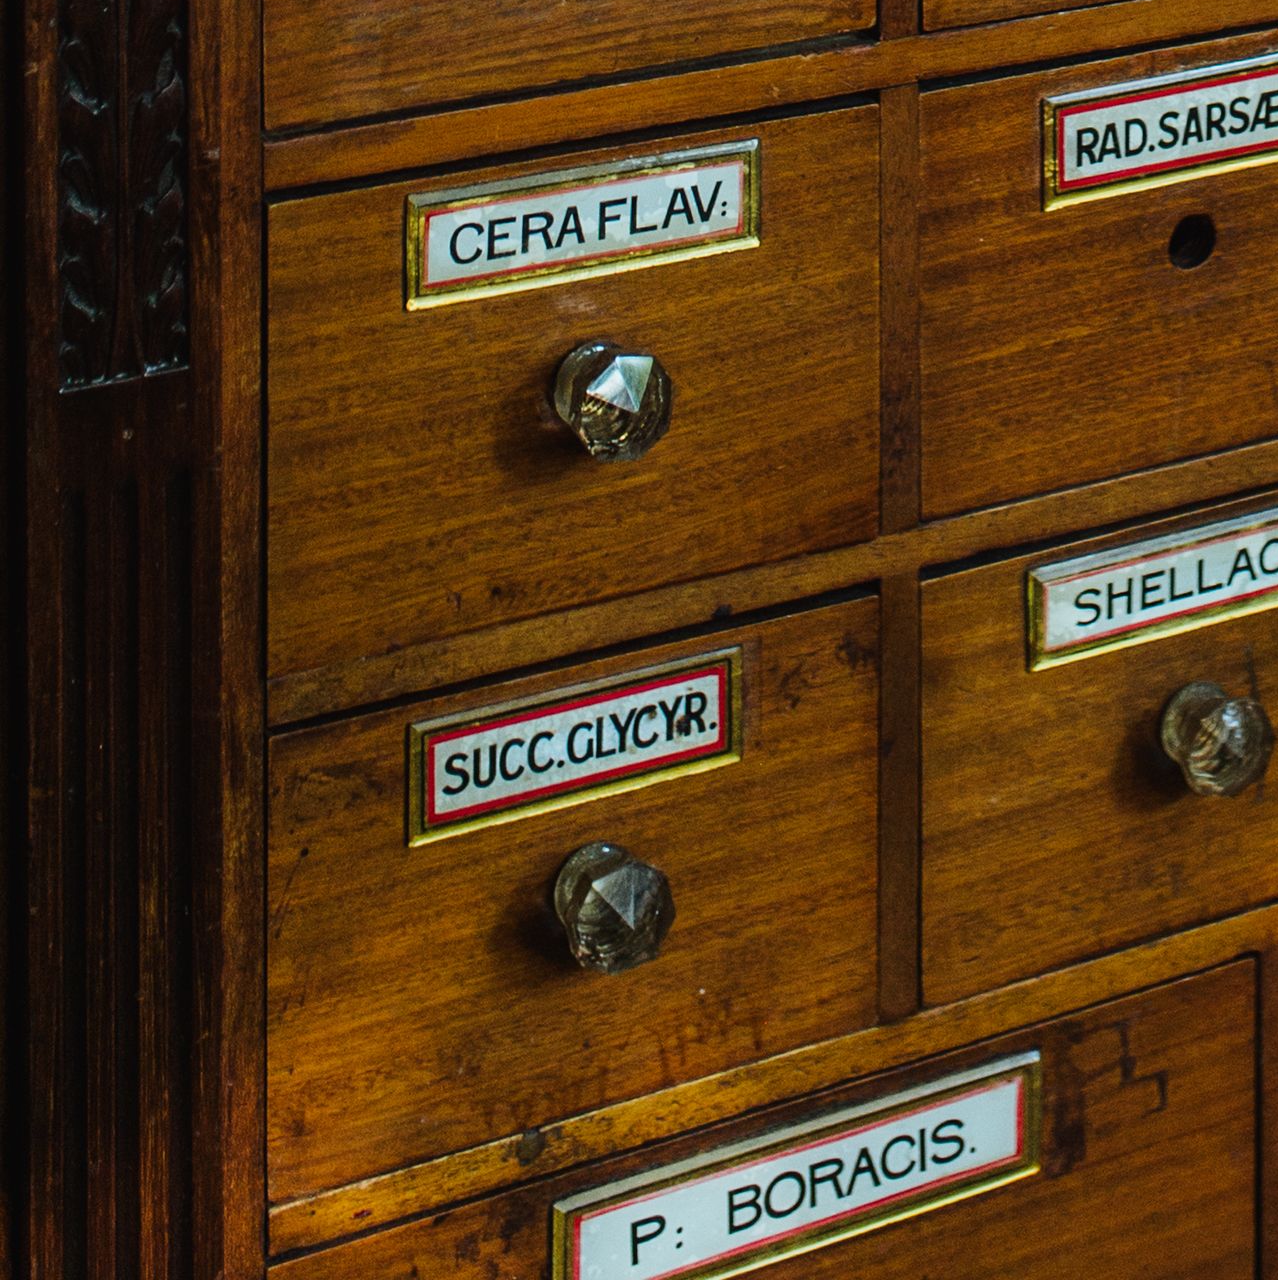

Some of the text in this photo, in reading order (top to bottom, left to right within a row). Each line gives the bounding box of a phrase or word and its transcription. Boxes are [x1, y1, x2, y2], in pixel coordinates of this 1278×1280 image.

[450, 180, 729, 266] CERA FLAV:
[727, 1119, 976, 1236] BORACIS.
